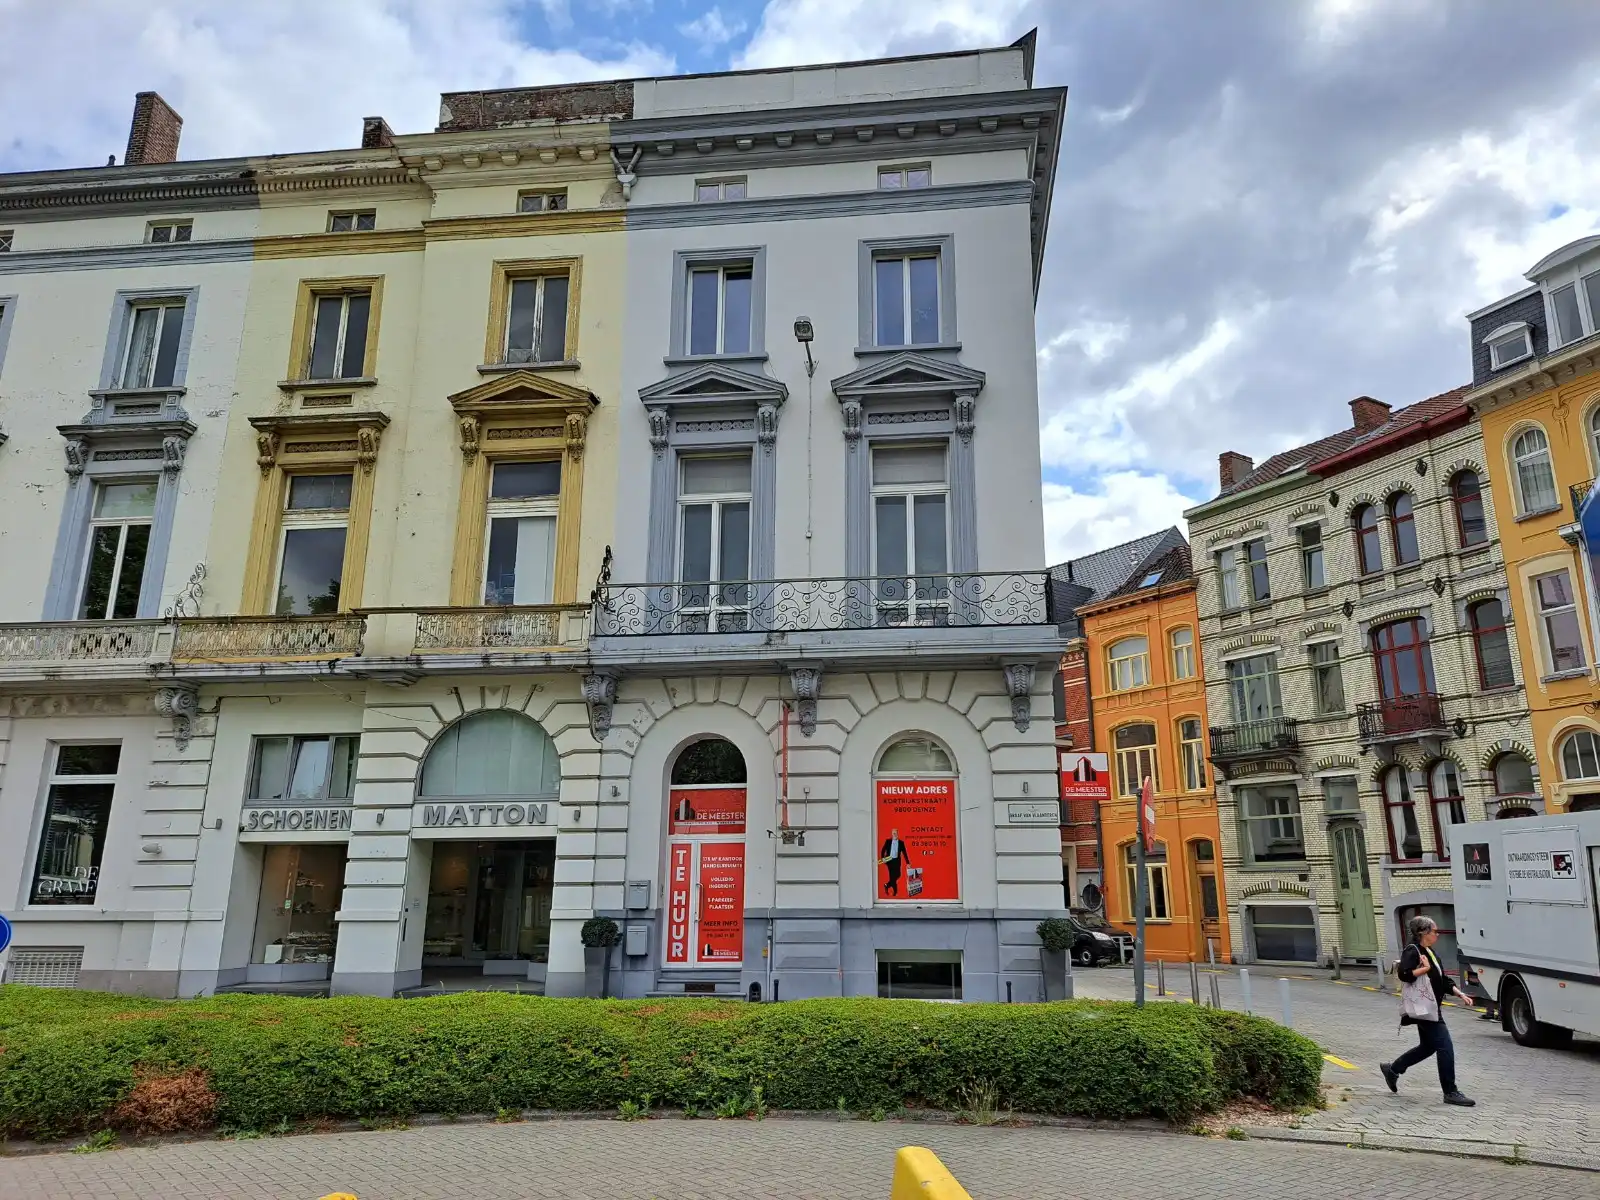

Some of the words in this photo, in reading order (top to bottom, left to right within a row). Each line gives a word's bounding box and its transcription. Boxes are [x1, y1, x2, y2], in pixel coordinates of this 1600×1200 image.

[881, 786, 914, 795] NIEUW
[915, 785, 948, 794] ADRES
[247, 808, 353, 830] SCHOENEN
[423, 803, 548, 826] MATTON
[74, 866, 99, 880] DE
[675, 849, 687, 881] TE
[1466, 862, 1489, 874] LOOMIS
[38, 880, 97, 894] GRAAF
[671, 890, 687, 958] HUUR
